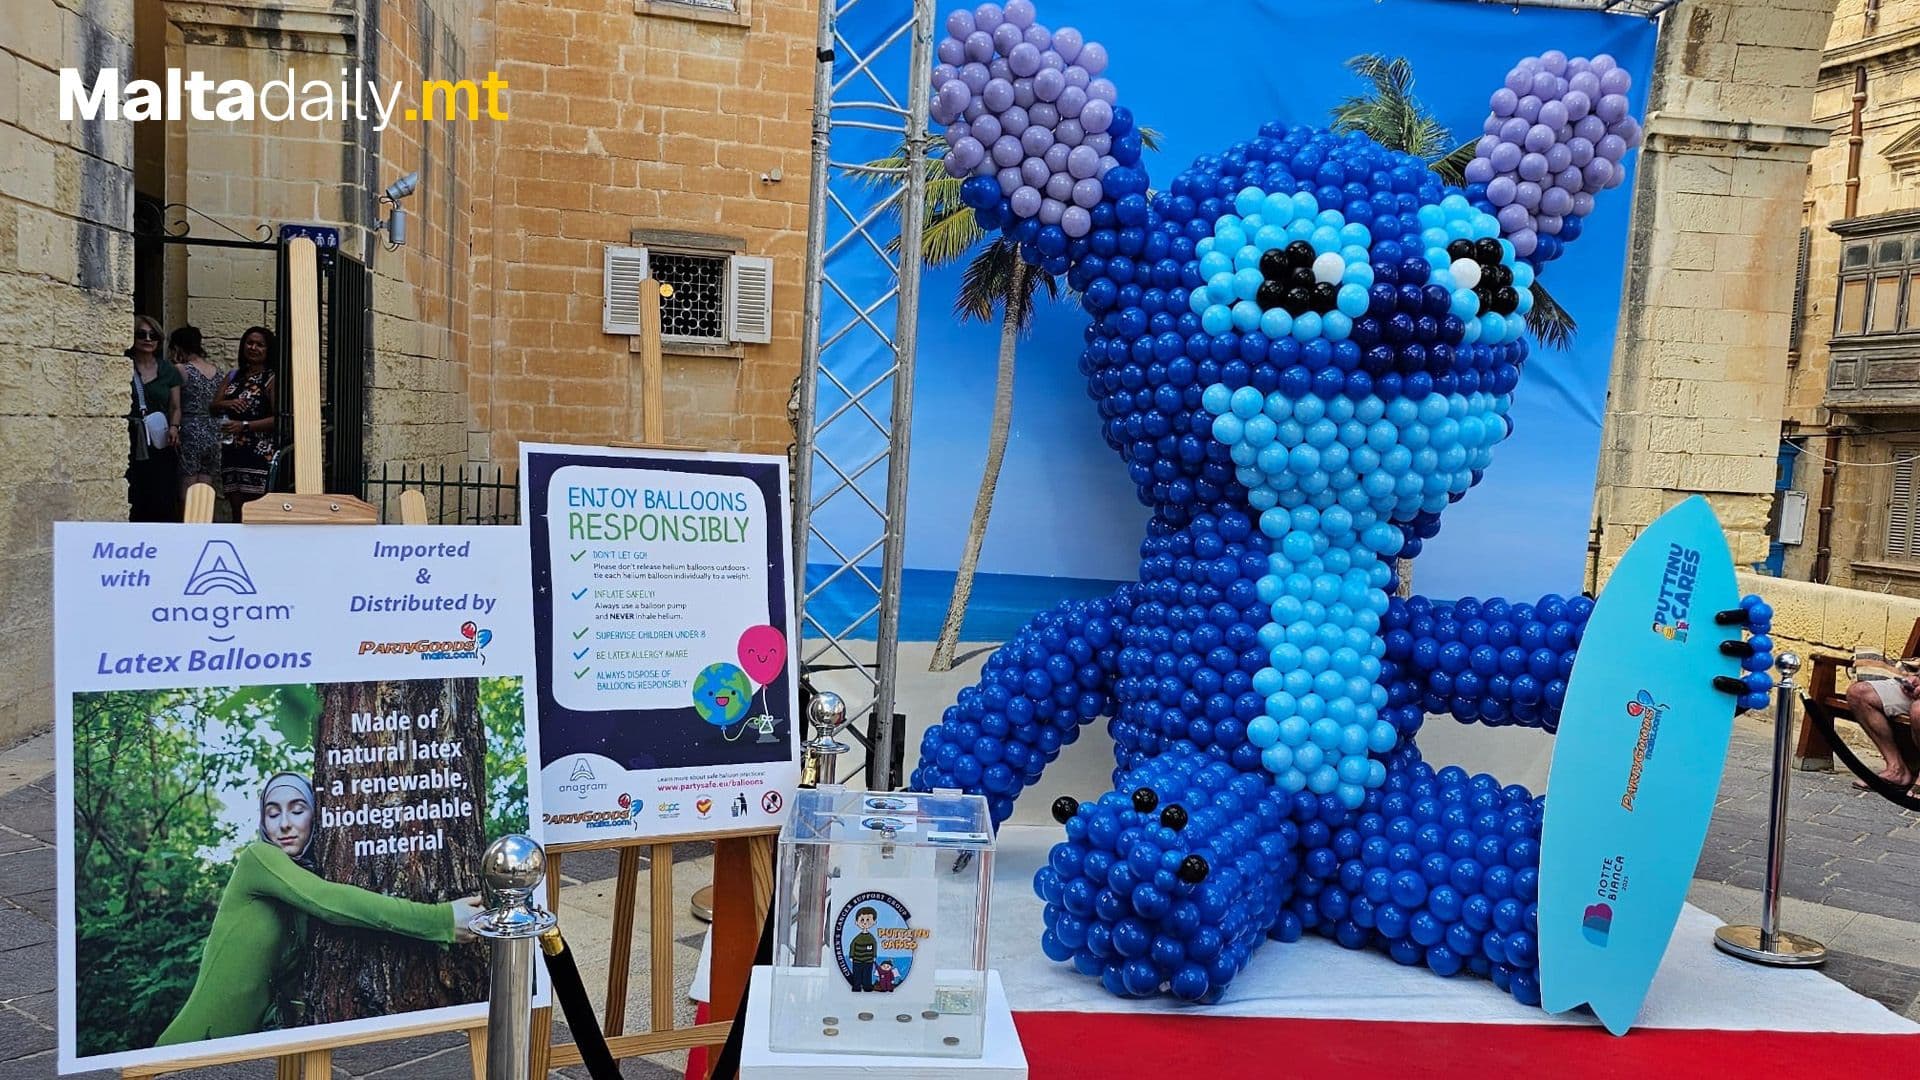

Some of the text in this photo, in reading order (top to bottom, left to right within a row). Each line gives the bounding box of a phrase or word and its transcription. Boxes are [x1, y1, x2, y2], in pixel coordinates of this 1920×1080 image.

[568, 487, 748, 512] ENJOY BALLOONS
[569, 512, 750, 543] RESPONSIBLY
[92, 542, 158, 560] Made
[373, 541, 470, 561] Imported
[618, 551, 631, 559] LET
[415, 567, 432, 585] &
[662, 563, 685, 571] helium
[686, 563, 715, 571] balloons
[673, 573, 711, 581] individually
[100, 569, 151, 588] with
[1654, 542, 1684, 625] PUTTINU
[1670, 548, 1701, 620] CARES
[349, 594, 497, 614] Distributed by
[594, 590, 625, 599] INFLATE
[151, 604, 290, 628] anagram
[596, 631, 637, 640] SUPERVISE
[638, 631, 674, 639] CHILDREN
[675, 630, 699, 639] UNDER
[97, 646, 312, 675] Latex Balloons
[596, 650, 689, 660] BE LATEX ALLERGY AWARE
[596, 670, 672, 679] ALWAYS DISPOSE OF
[597, 680, 688, 691] BALLOONS RESPONSIBLY
[351, 708, 439, 733] Made of
[328, 739, 463, 765] natural latex
[331, 780, 344, 796] a
[351, 767, 468, 795] renewable,
[559, 783, 608, 794] anagram
[657, 779, 764, 791] www.partysafe.eu/balloons
[321, 797, 473, 829] biodegradable
[354, 828, 444, 857] material
[1597, 857, 1613, 898] NOTTE
[1607, 855, 1625, 901] BIANCA
[836, 904, 853, 932] CANCER
[853, 893, 886, 905] SUPPORT
[886, 896, 908, 917] GROUP
